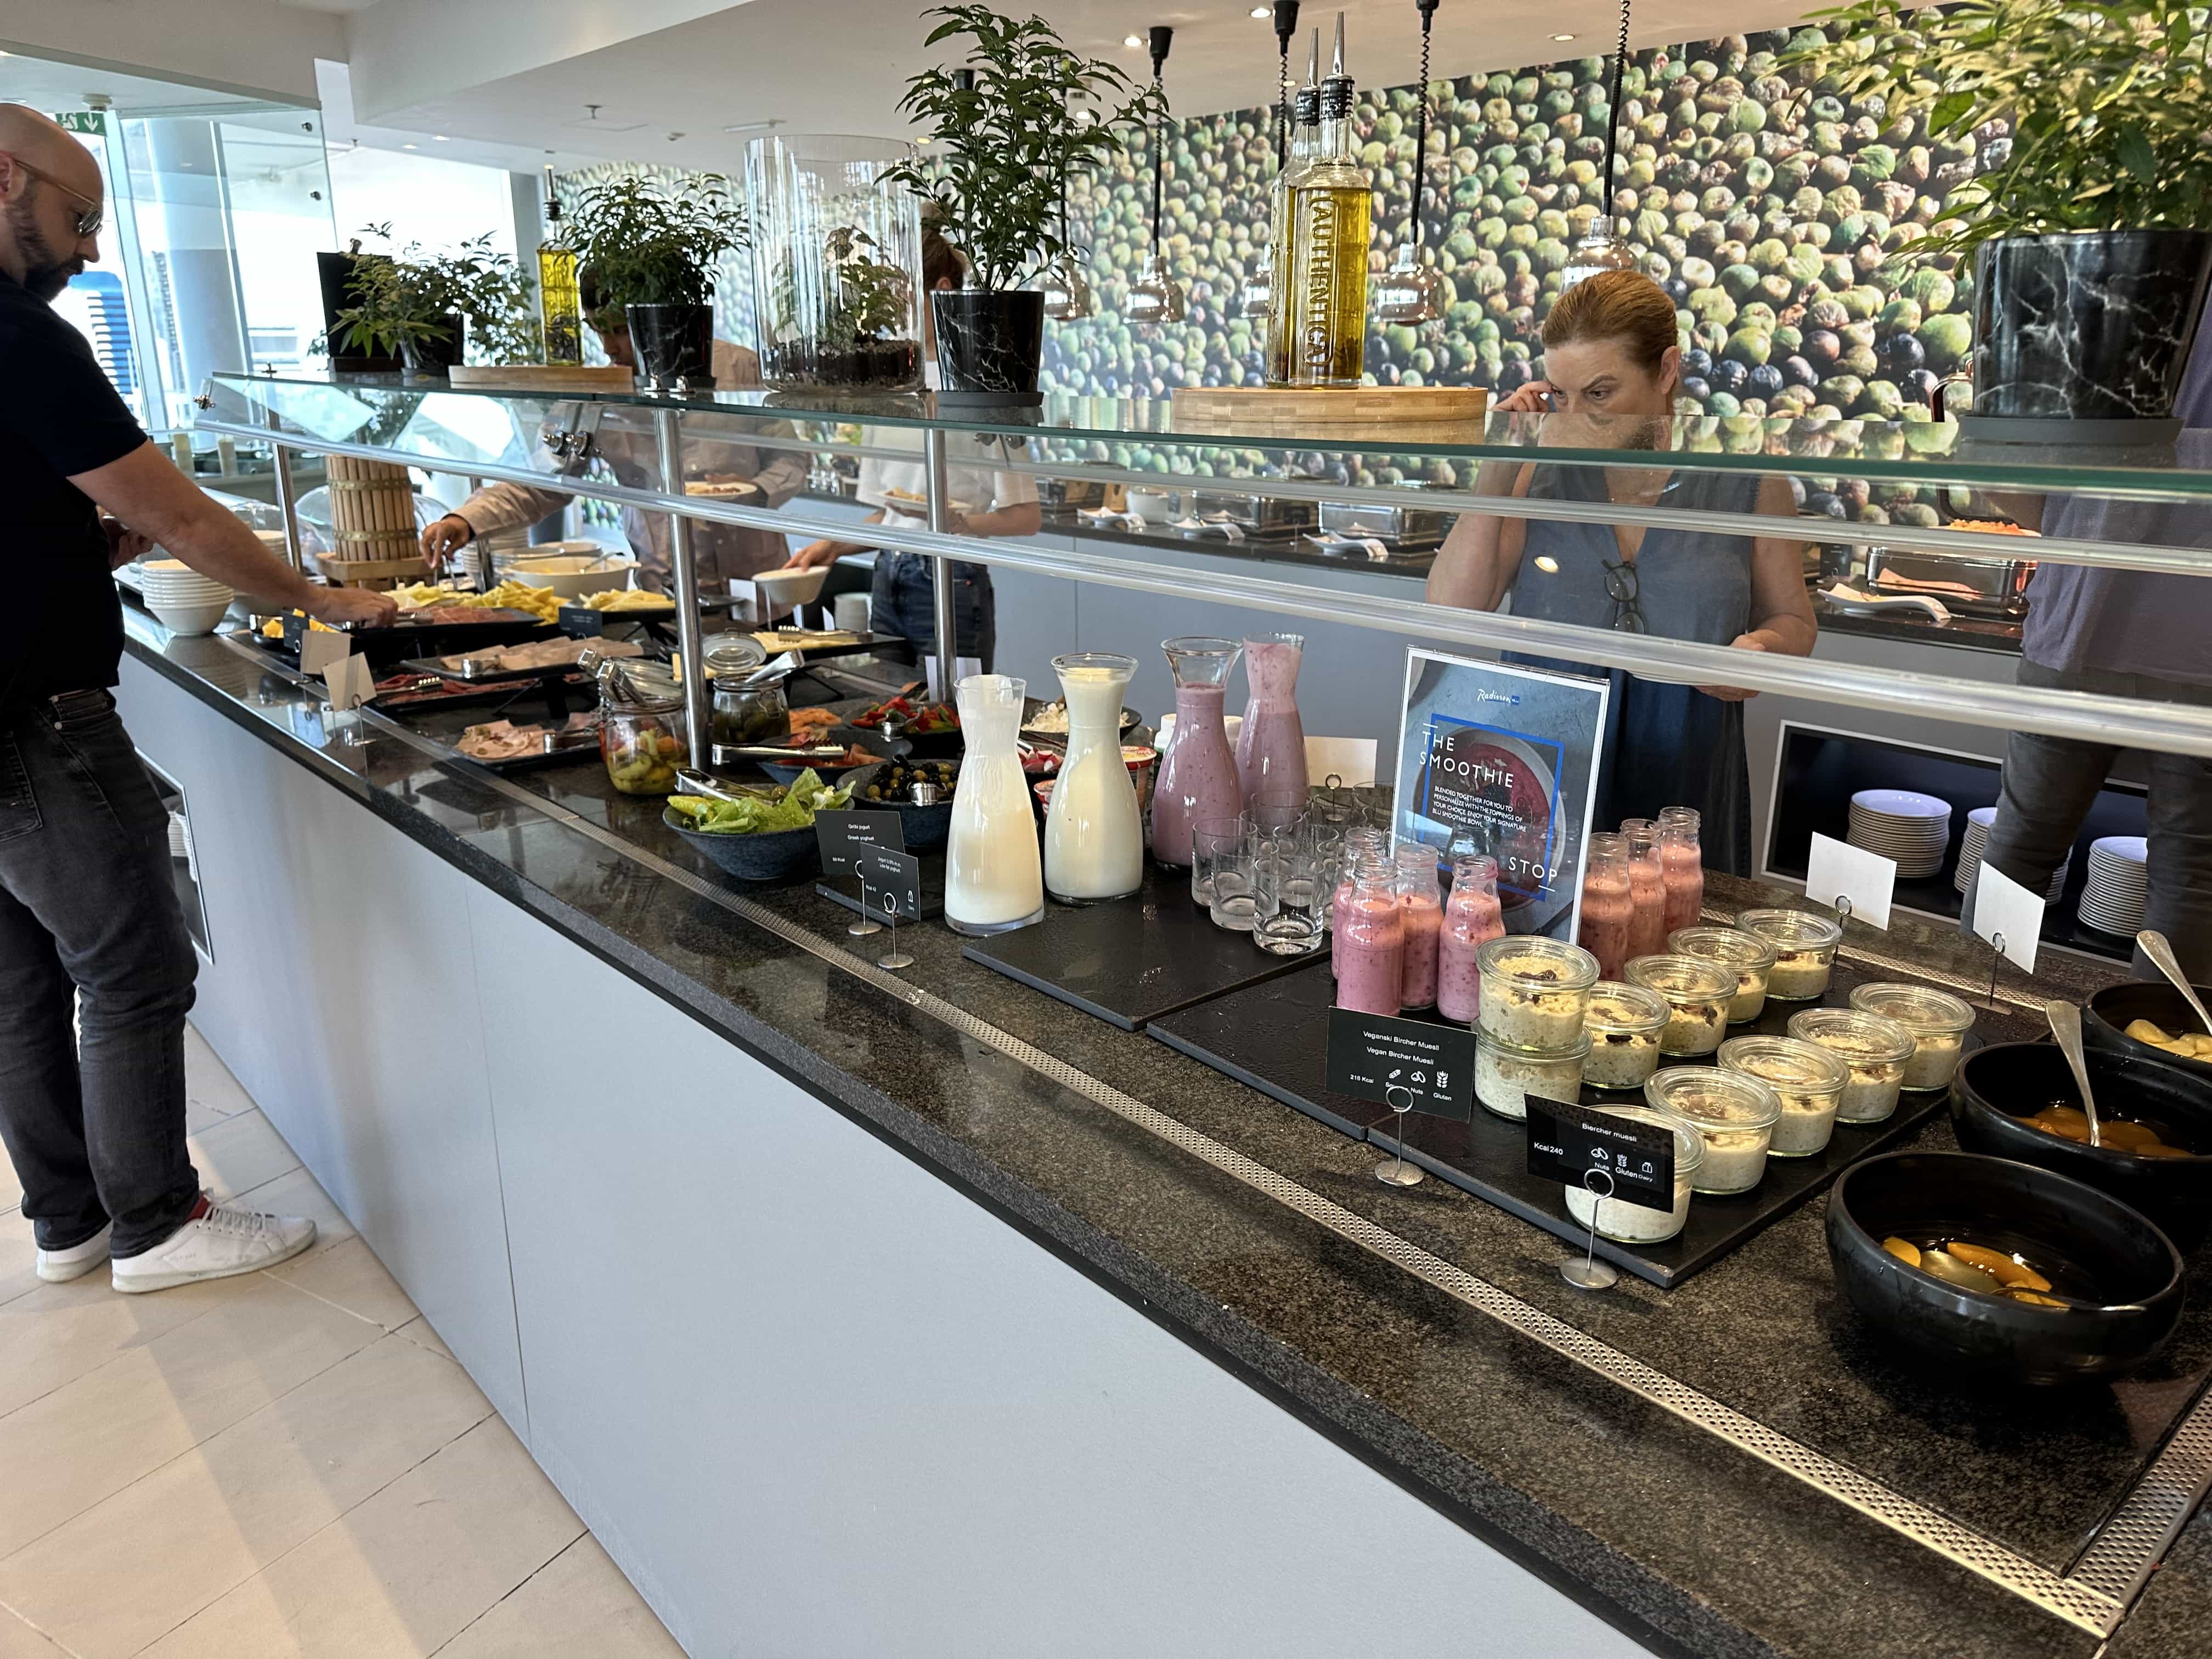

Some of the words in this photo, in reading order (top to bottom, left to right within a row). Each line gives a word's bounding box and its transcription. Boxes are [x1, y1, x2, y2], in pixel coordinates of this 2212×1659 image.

[1307, 206, 1331, 357] AUTHENTICA
[1477, 689, 1511, 703] Radisson
[1422, 731, 1454, 751] THE
[1419, 751, 1514, 788] SMOOTHIE
[1434, 793, 1464, 806] PERSONALIZE
[1465, 802, 1479, 810] WITH
[1489, 809, 1514, 820] TOPPINGS
[1435, 786, 1456, 796] BLENDED
[1456, 792, 1482, 804] TOGETHER
[1493, 802, 1505, 810] YOU
[1442, 811, 1466, 823] SMOOTHIE
[1468, 818, 1483, 827] BOWL
[1467, 810, 1483, 819] ENJOY
[1483, 815, 1496, 823] YOUR
[1497, 819, 1527, 832] SIGNATURE
[1509, 856, 1558, 882] STOP
[1363, 1030, 1392, 1042] Veganski
[1393, 1036, 1417, 1047] Bircher
[1418, 1041, 1440, 1051] Muesli
[1367, 1046, 1387, 1056] Vegan
[1388, 1051, 1412, 1060] Bircher
[1413, 1055, 1434, 1065] Muesli
[1362, 1076, 1374, 1084] Kcal
[1433, 1092, 1452, 1101] Gluten
[1582, 1123, 1612, 1136] Biercher
[1613, 1132, 1637, 1143] muesli
[1534, 1142, 1549, 1152] Kcal
[1550, 1146, 1564, 1155] 240
[1594, 1162, 1610, 1171] Nuts
[1615, 1167, 1638, 1178] Gluten
[1638, 1174, 1653, 1182] Dairy
